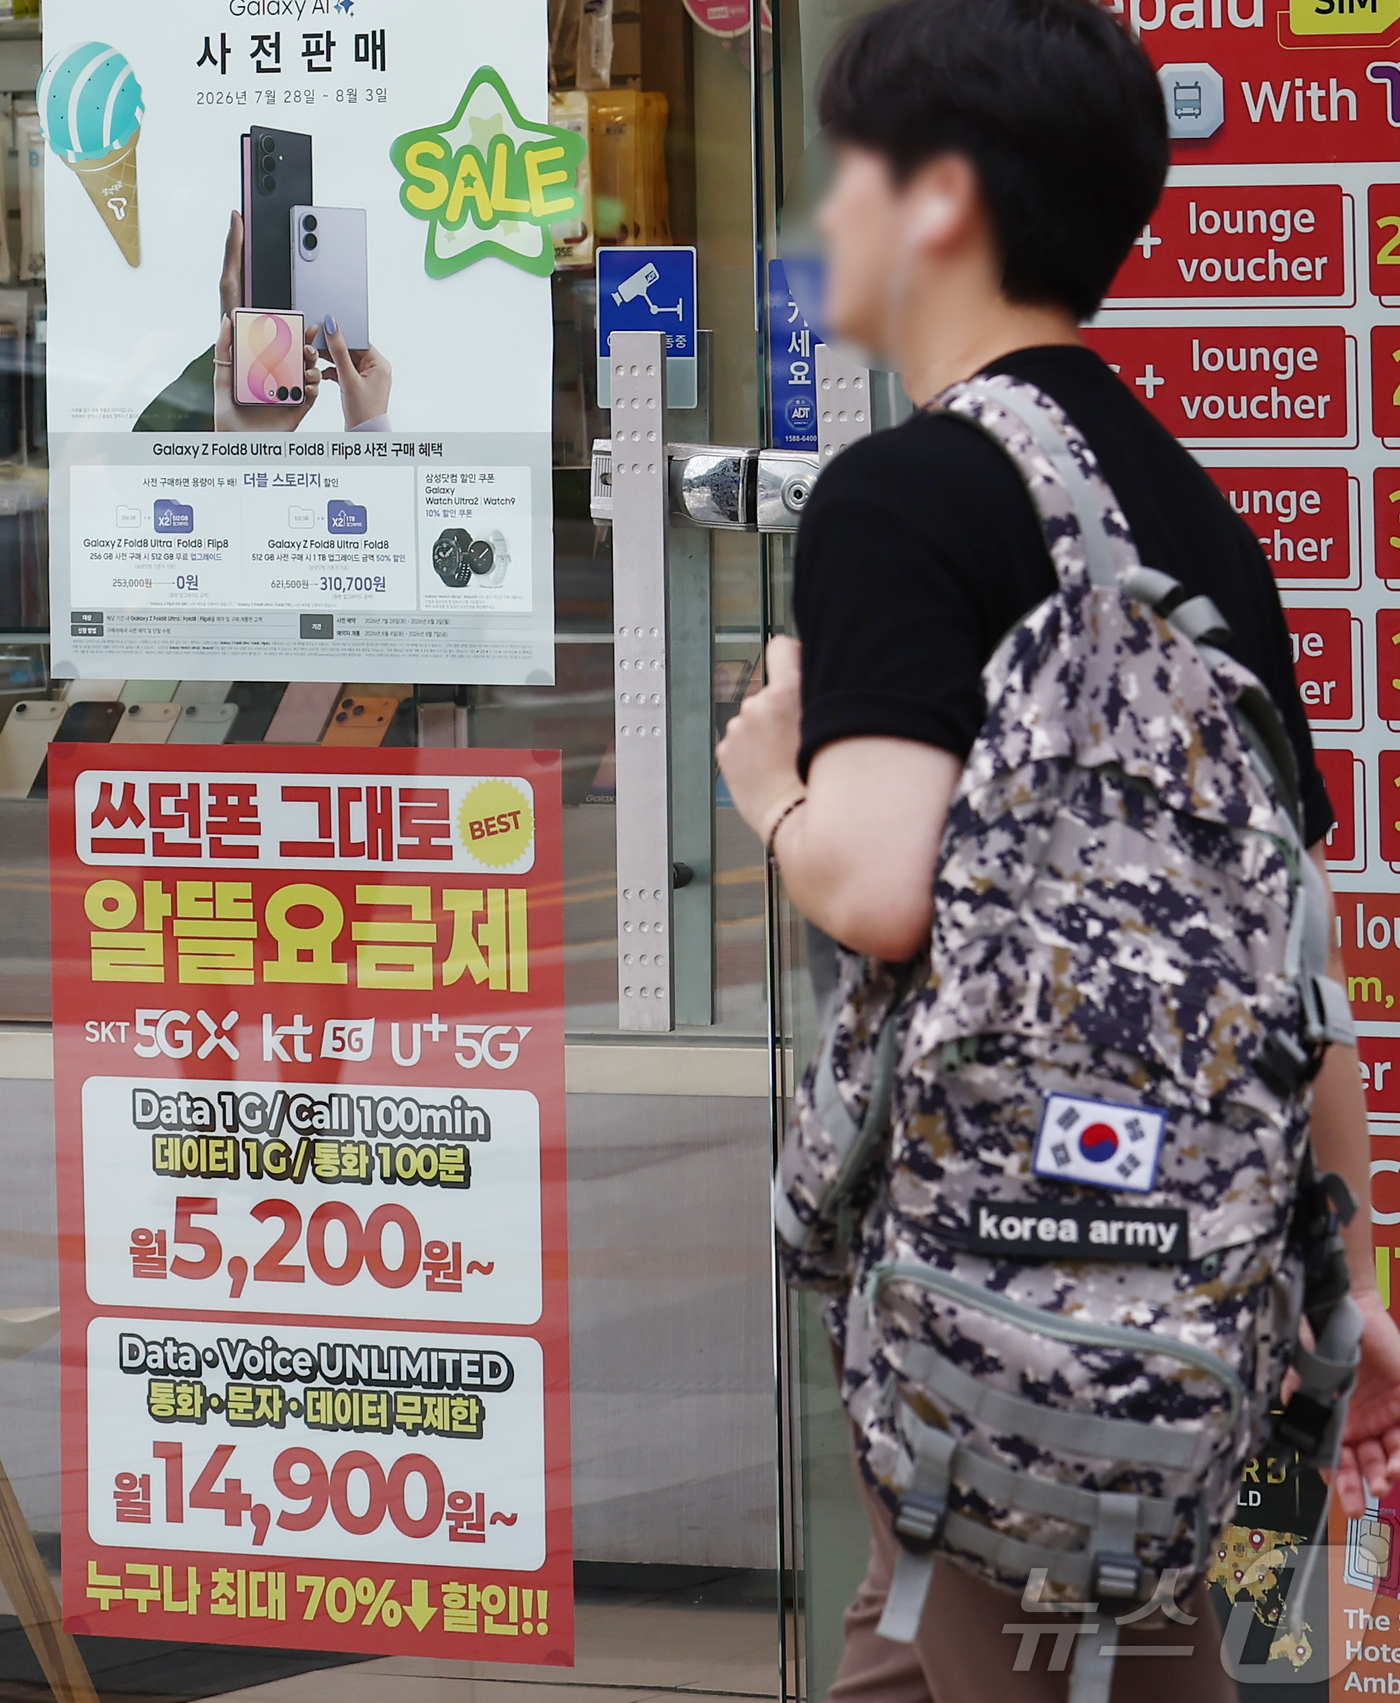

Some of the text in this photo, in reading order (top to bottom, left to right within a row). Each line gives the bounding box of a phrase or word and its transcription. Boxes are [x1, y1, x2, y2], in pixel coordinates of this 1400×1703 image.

[229, 0, 329, 20] Galaxy AI
[197, 90, 247, 105] 2026년
[255, 90, 275, 104] 7월
[284, 89, 315, 104] 28일
[336, 88, 357, 103] 8월
[365, 87, 387, 103] 3일
[1241, 78, 1357, 122] With
[405, 141, 575, 222] SALE
[1189, 202, 1315, 242] lounge
[1178, 249, 1328, 282] voucher
[665, 334, 687, 349] 동중
[1192, 339, 1318, 379] lounge
[1181, 386, 1330, 419] voucher
[792, 407, 810, 419] ADT
[785, 434, 818, 443] 1588-6400
[153, 443, 443, 459] Galaxy Z Fold8 Ultra Fold8 Flip8 사전 구매 혜택
[143, 473, 339, 488] 사전 구매하면 용량이 두 배! 더블 스토리지 할인
[425, 474, 495, 483] 삼성닷컴 할인 쿠폰
[425, 486, 455, 496] Galaxy
[425, 497, 516, 505] Watch Ultra2 Watch9
[425, 509, 473, 518] 10% 할인 쿠폰
[1229, 489, 1322, 523] unge
[158, 517, 170, 527] X2
[332, 517, 344, 528] X2
[83, 539, 229, 550] Galaxy Z Fold8 Ultra Fold8 Flip8
[268, 540, 389, 551] Galaxy Z Fold8 Ultra Fold8
[1258, 529, 1334, 562] cher
[252, 554, 263, 562] 512
[264, 554, 275, 562] GB
[276, 554, 289, 562] 사전
[290, 554, 303, 562] 구매
[317, 554, 326, 562] TB
[328, 554, 361, 562] 업그레이드
[362, 554, 375, 562] 금액
[376, 554, 391, 562] 50%
[393, 554, 405, 562] 할인
[113, 579, 152, 588] 253,000원
[177, 574, 198, 590] 0원
[271, 580, 309, 589] 621,500원
[320, 576, 386, 592] 310,700원
[585, 794, 616, 803] Galax
[91, 781, 454, 863] 쓰던폰 그대로
[468, 809, 522, 842] BEST
[83, 879, 529, 993] 알뜰요금제
[86, 1009, 240, 1061] SKT 5GX
[263, 1013, 364, 1064] kt 5G
[134, 1090, 213, 1126] Data
[359, 1096, 486, 1136] 100min
[155, 1136, 235, 1174] 데이터
[379, 1144, 466, 1183] 100분
[979, 1206, 1179, 1254] korea army
[320, 1345, 509, 1388] UNLIMITED
[395, 1395, 480, 1433] 무제한
[87, 1560, 549, 1638] 누구나 최대 70% 할인!!
[1343, 1608, 1391, 1631] The
